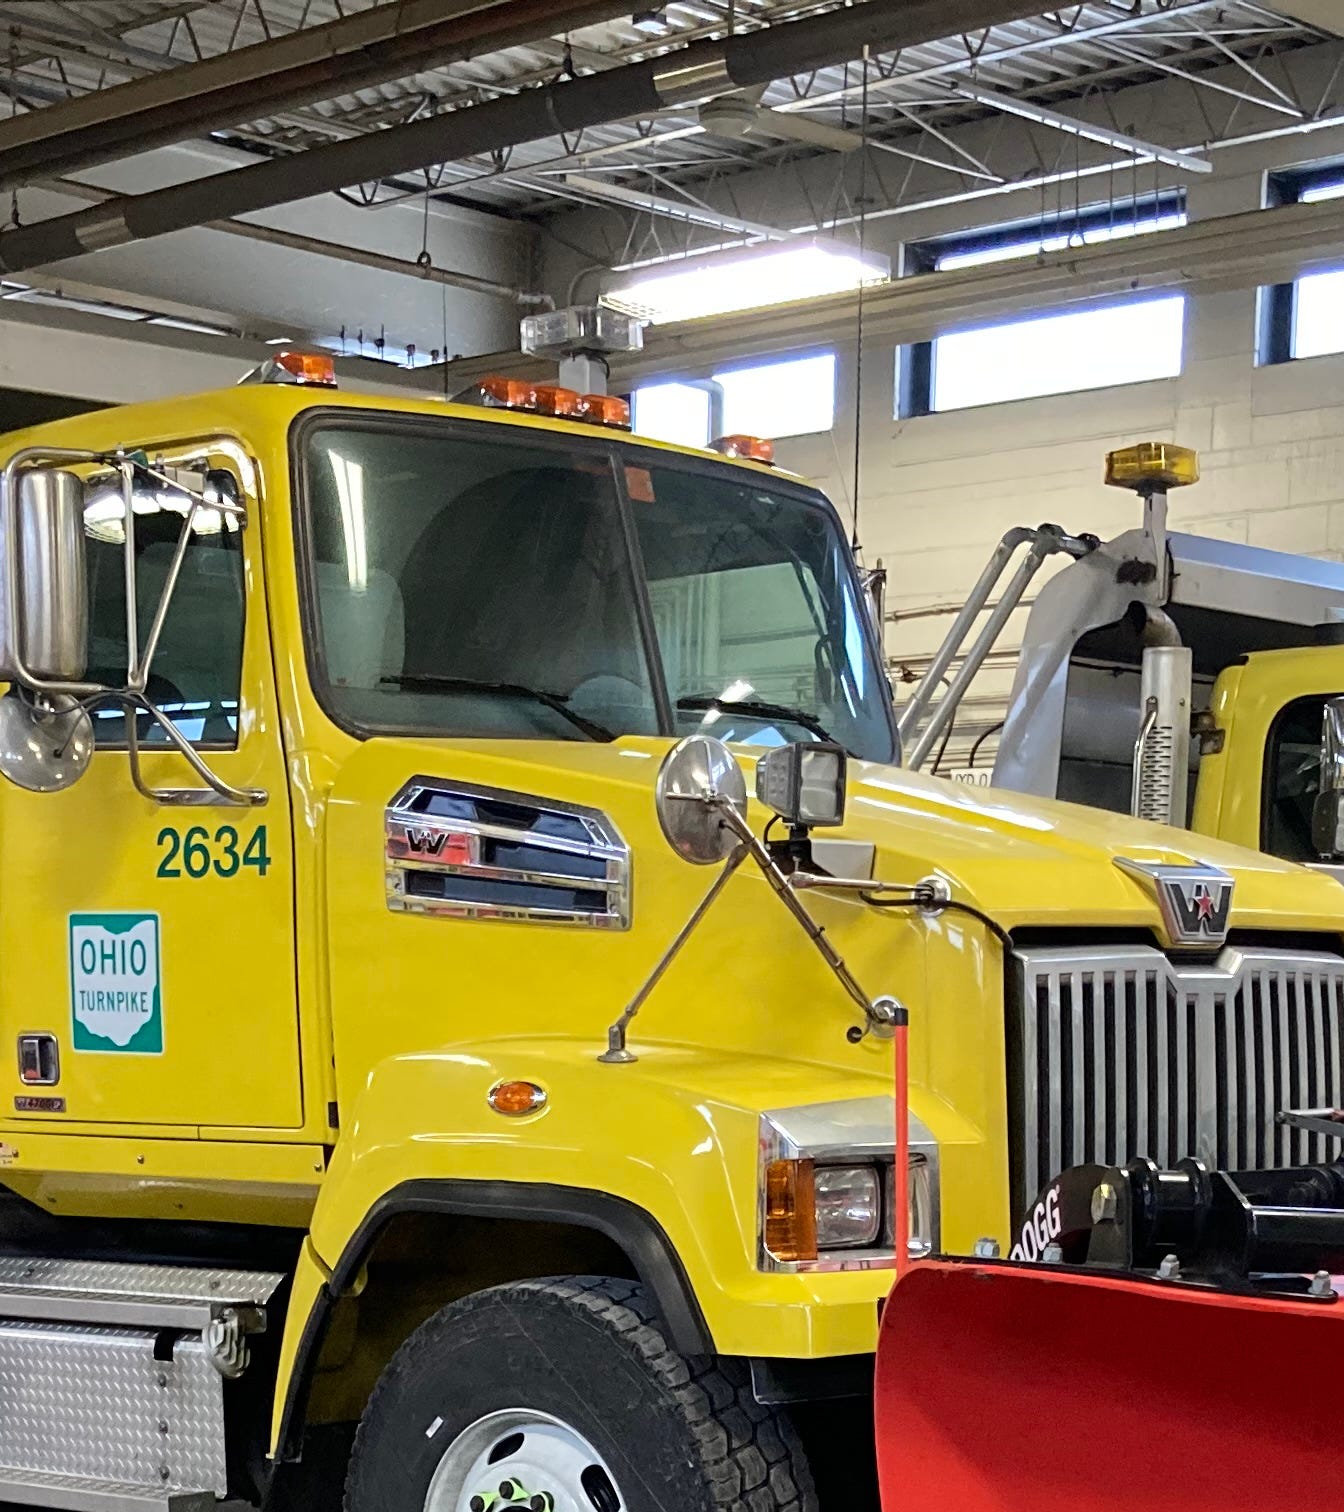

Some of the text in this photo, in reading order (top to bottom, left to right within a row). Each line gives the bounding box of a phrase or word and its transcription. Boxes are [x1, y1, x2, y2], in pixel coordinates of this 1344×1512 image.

[156, 825, 272, 878] 2634
[80, 938, 147, 976] OHIO
[79, 990, 149, 1013] TURNPIKE
